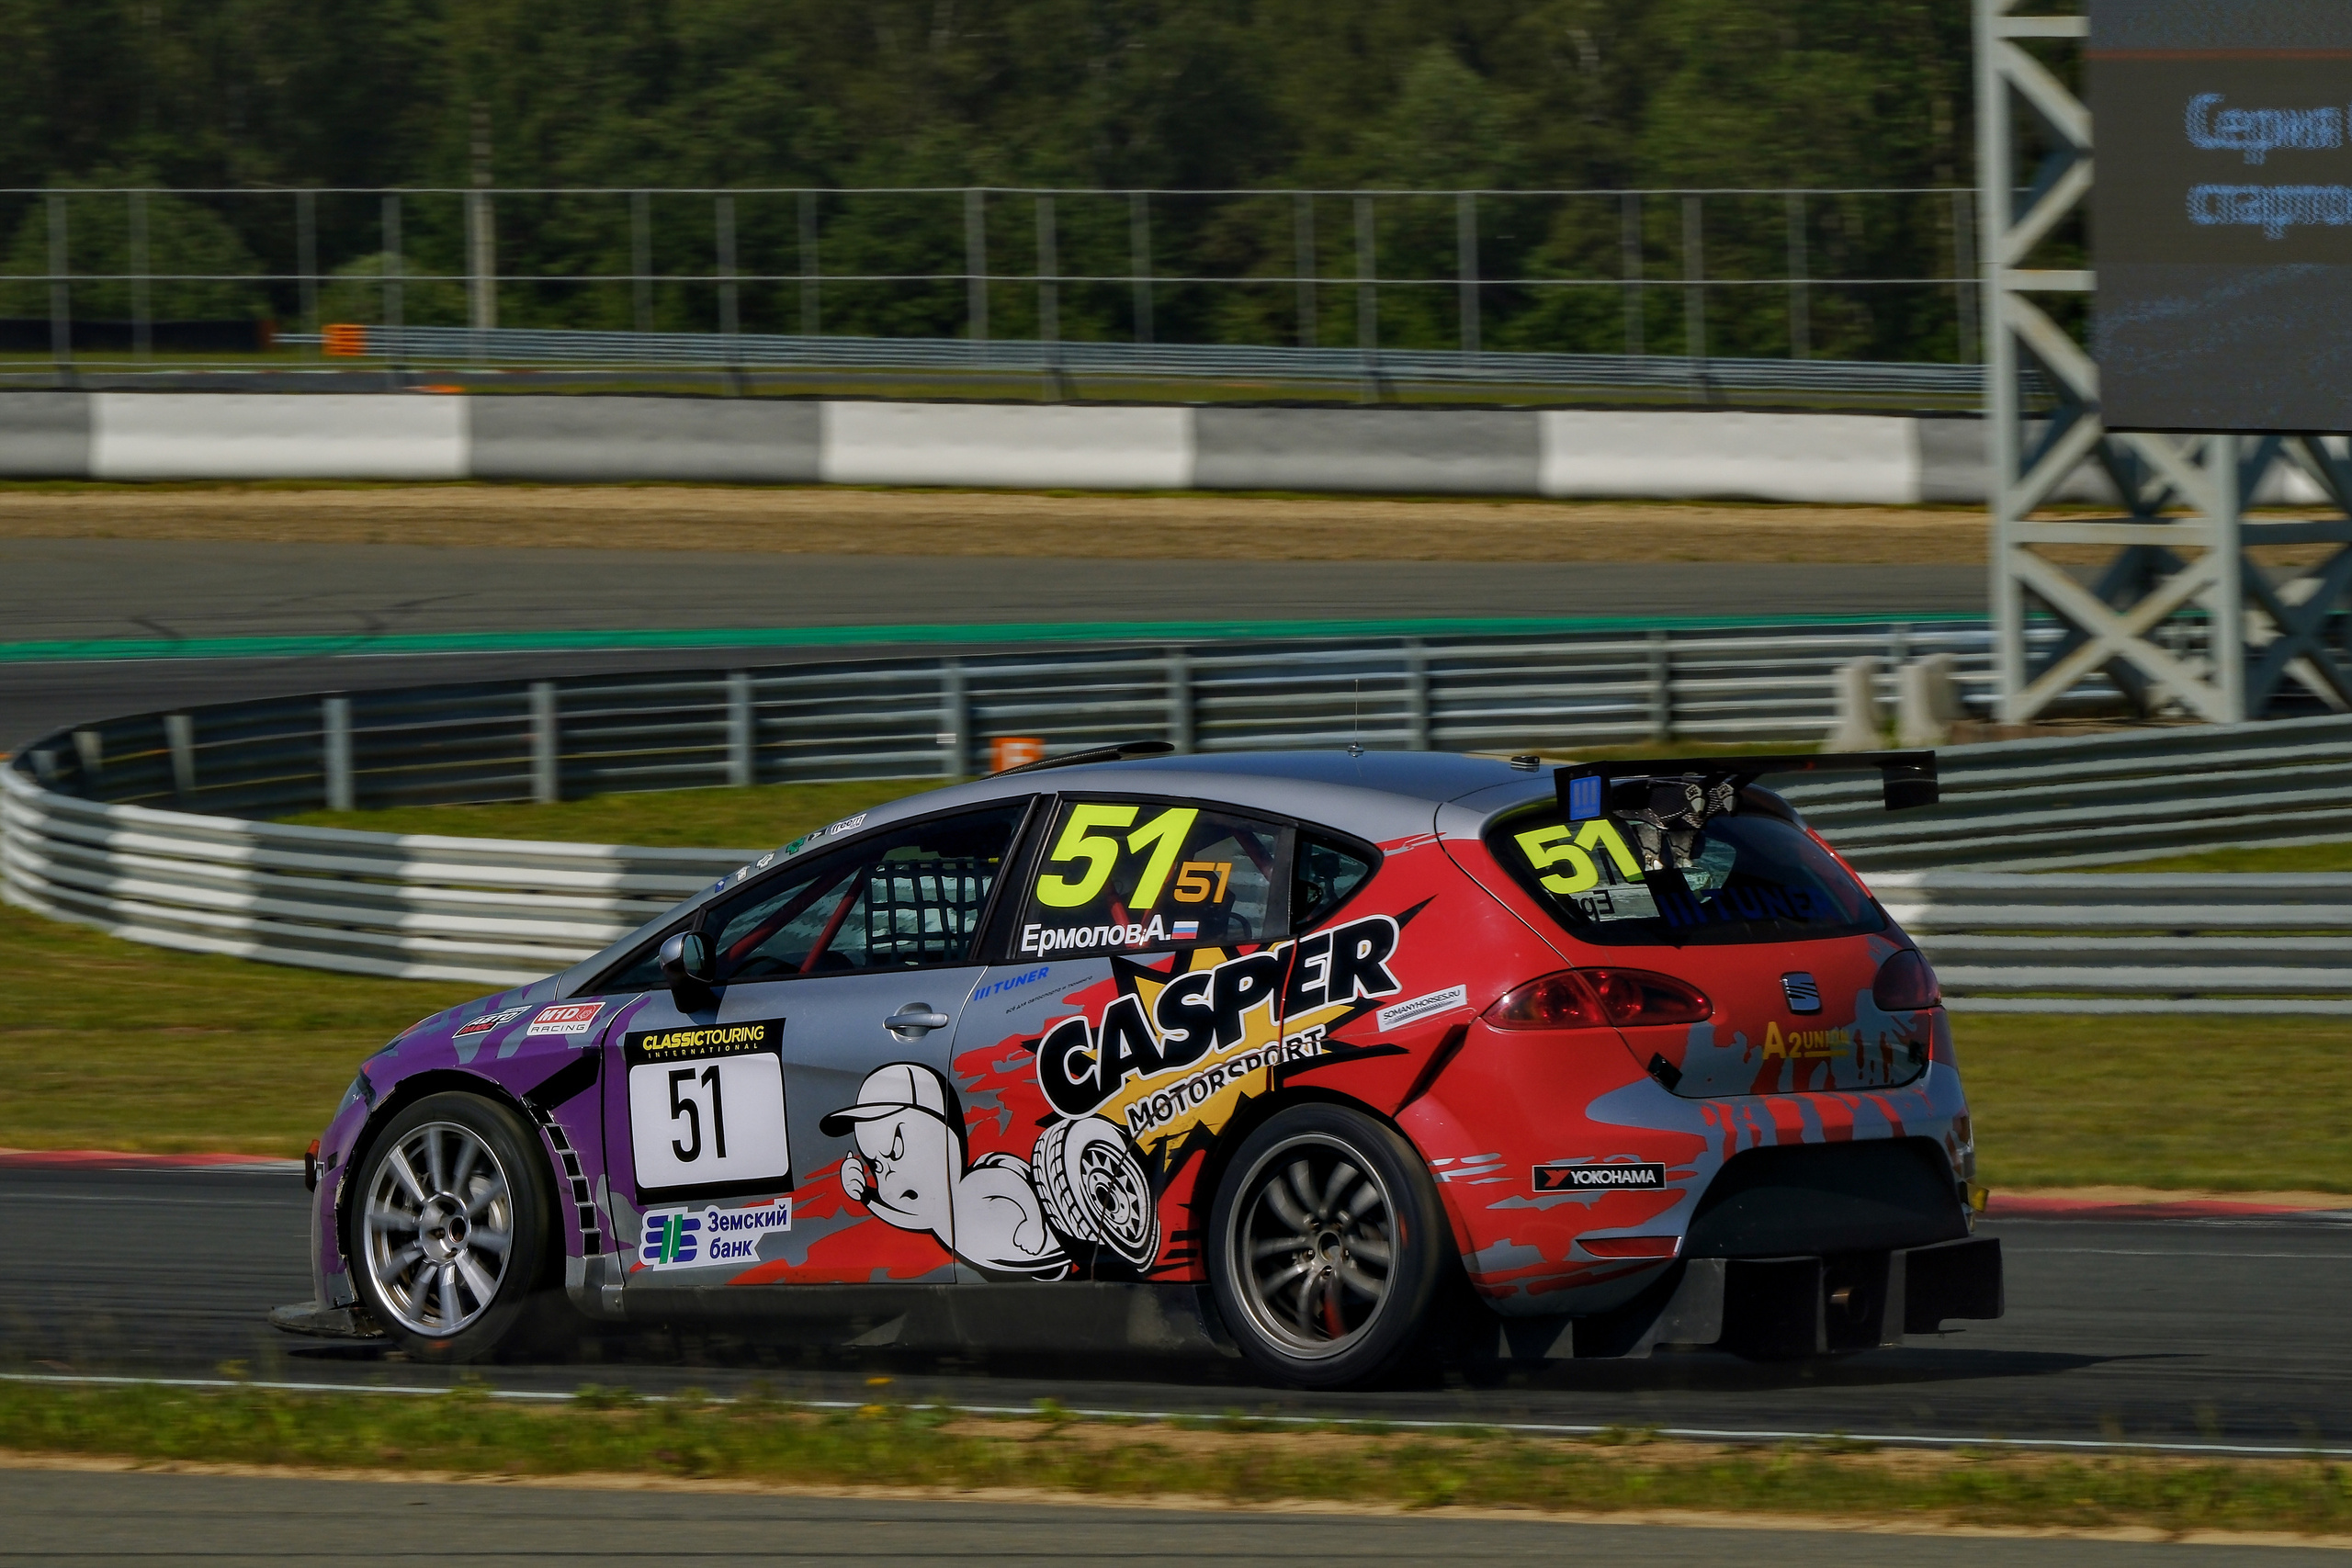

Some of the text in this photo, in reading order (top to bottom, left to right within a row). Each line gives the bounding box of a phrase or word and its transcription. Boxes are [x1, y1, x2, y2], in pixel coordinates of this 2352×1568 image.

[1036, 804, 1199, 909] 51
[1514, 819, 1645, 895] 51
[1173, 861, 1233, 904] 51
[993, 966, 1050, 995] TUNER
[467, 1011, 519, 1027] АВТО
[537, 1007, 580, 1022] M1D
[1036, 915, 1401, 1120] CASPER
[1383, 989, 1461, 1021] SOMANYHORSES.RU
[530, 1023, 586, 1032] RACING
[648, 1043, 759, 1059] INTERNATIONAL
[1126, 1026, 1328, 1139] MOTORSPORT
[668, 1065, 727, 1164] 51
[1570, 1169, 1657, 1185] YOKOHAMA
[707, 1204, 788, 1233] Земский
[708, 1237, 753, 1259] банк
